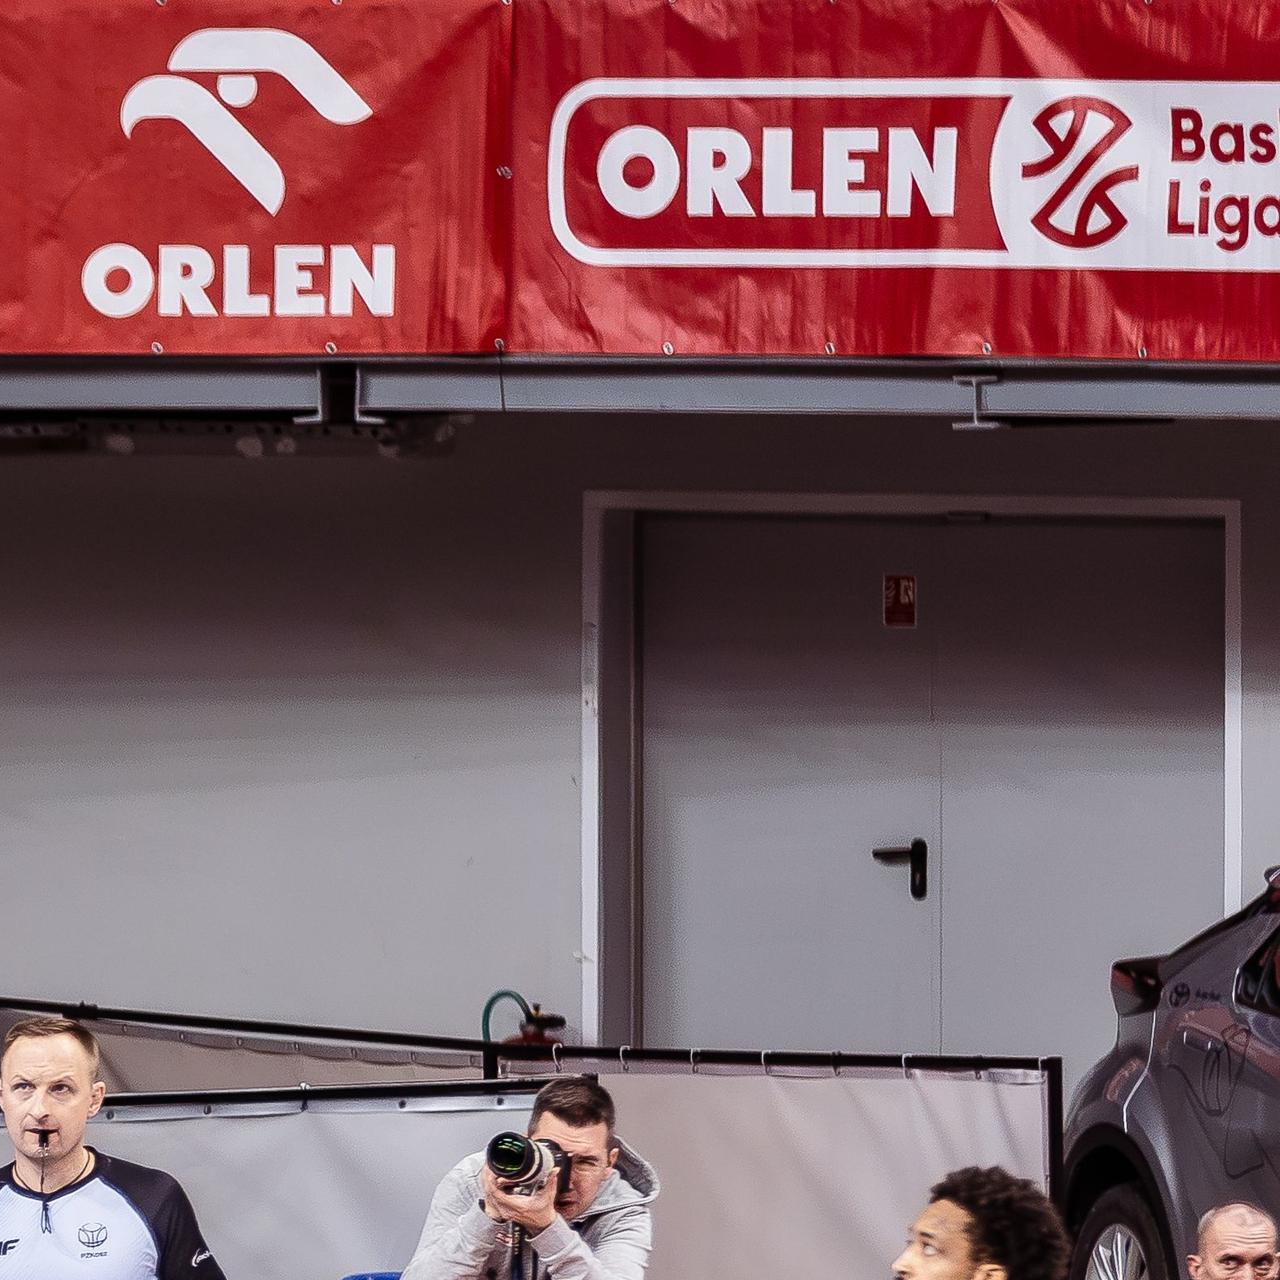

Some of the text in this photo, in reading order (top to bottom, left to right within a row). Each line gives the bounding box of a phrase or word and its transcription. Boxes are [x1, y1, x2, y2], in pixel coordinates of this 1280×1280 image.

[596, 125, 959, 218] ORLEN
[1170, 107, 1280, 165] Bas
[81, 244, 395, 318] ORLEN
